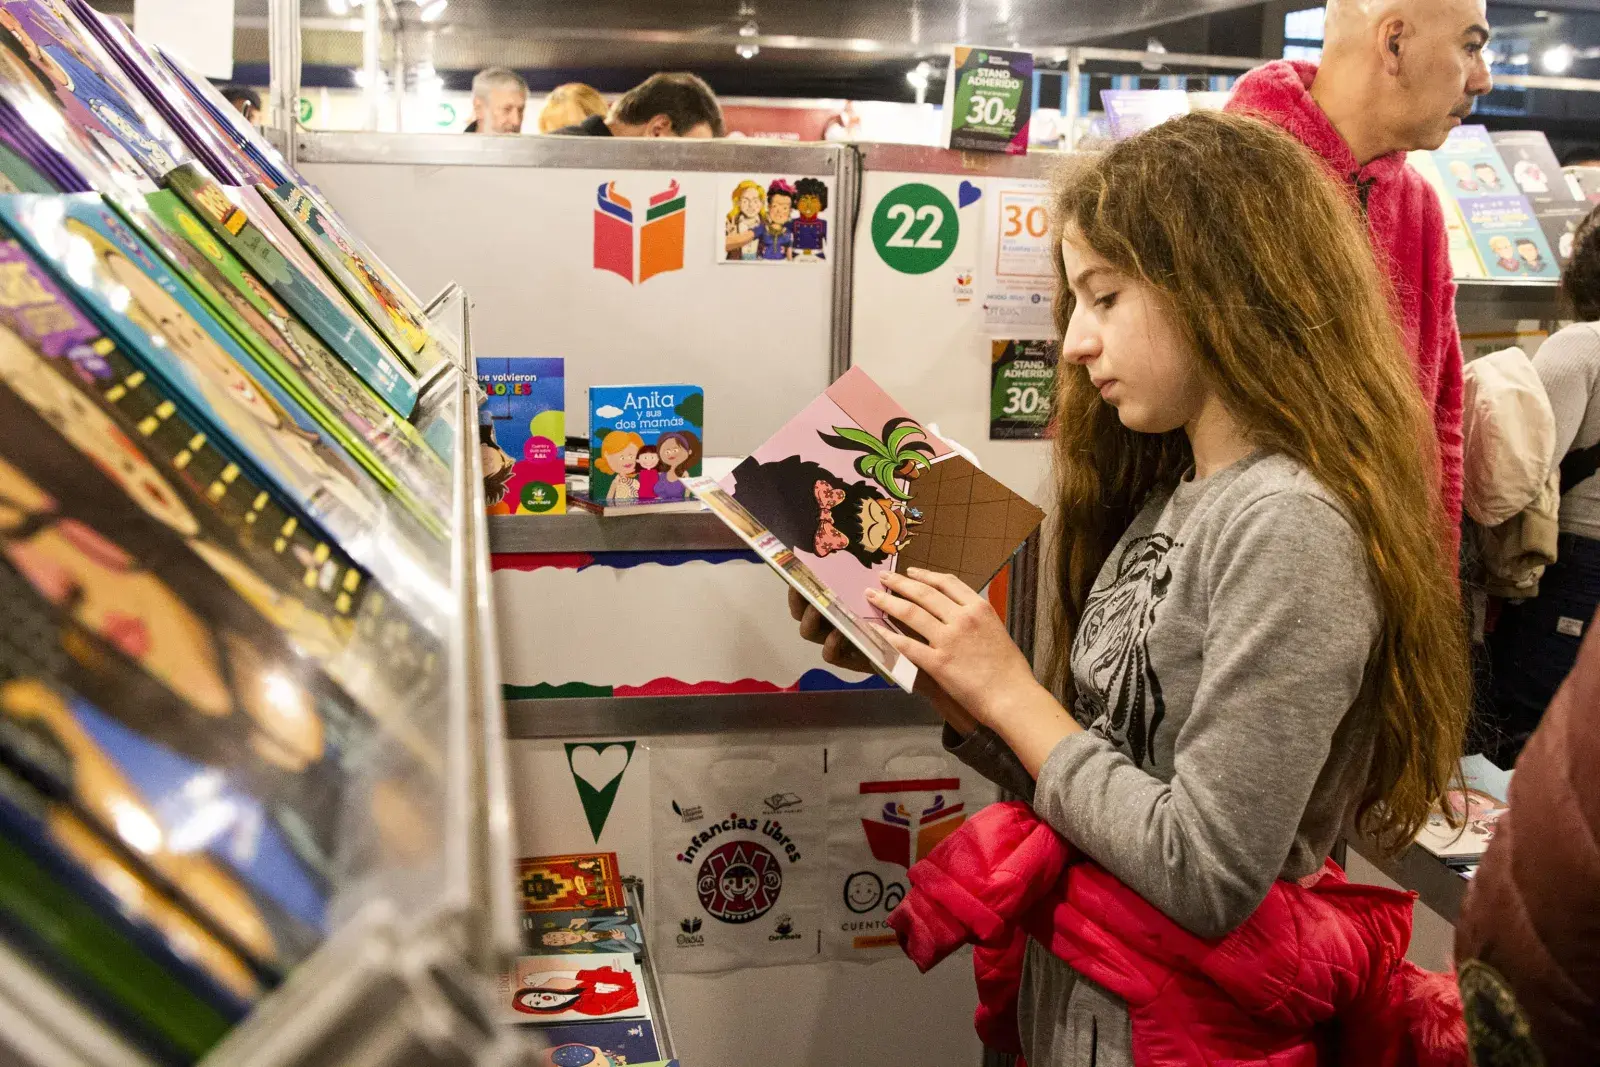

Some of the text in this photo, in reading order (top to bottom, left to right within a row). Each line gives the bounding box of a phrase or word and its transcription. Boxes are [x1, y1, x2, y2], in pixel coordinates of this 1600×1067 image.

[977, 67, 1011, 79] STAND
[967, 76, 1020, 89] ADHERIDO
[965, 95, 1016, 126] 30%
[885, 203, 944, 249] 22
[1004, 204, 1049, 238] 30
[1013, 360, 1045, 370] STAND
[478, 373, 537, 382] ue volvieron
[1004, 369, 1054, 378] ADHERIDO
[479, 382, 533, 396] OLORES
[623, 391, 675, 410] Anita
[1002, 386, 1051, 414] 30%
[636, 410, 662, 421] y sus
[615, 416, 684, 430] dos mamás
[677, 812, 801, 864] infancias libres
